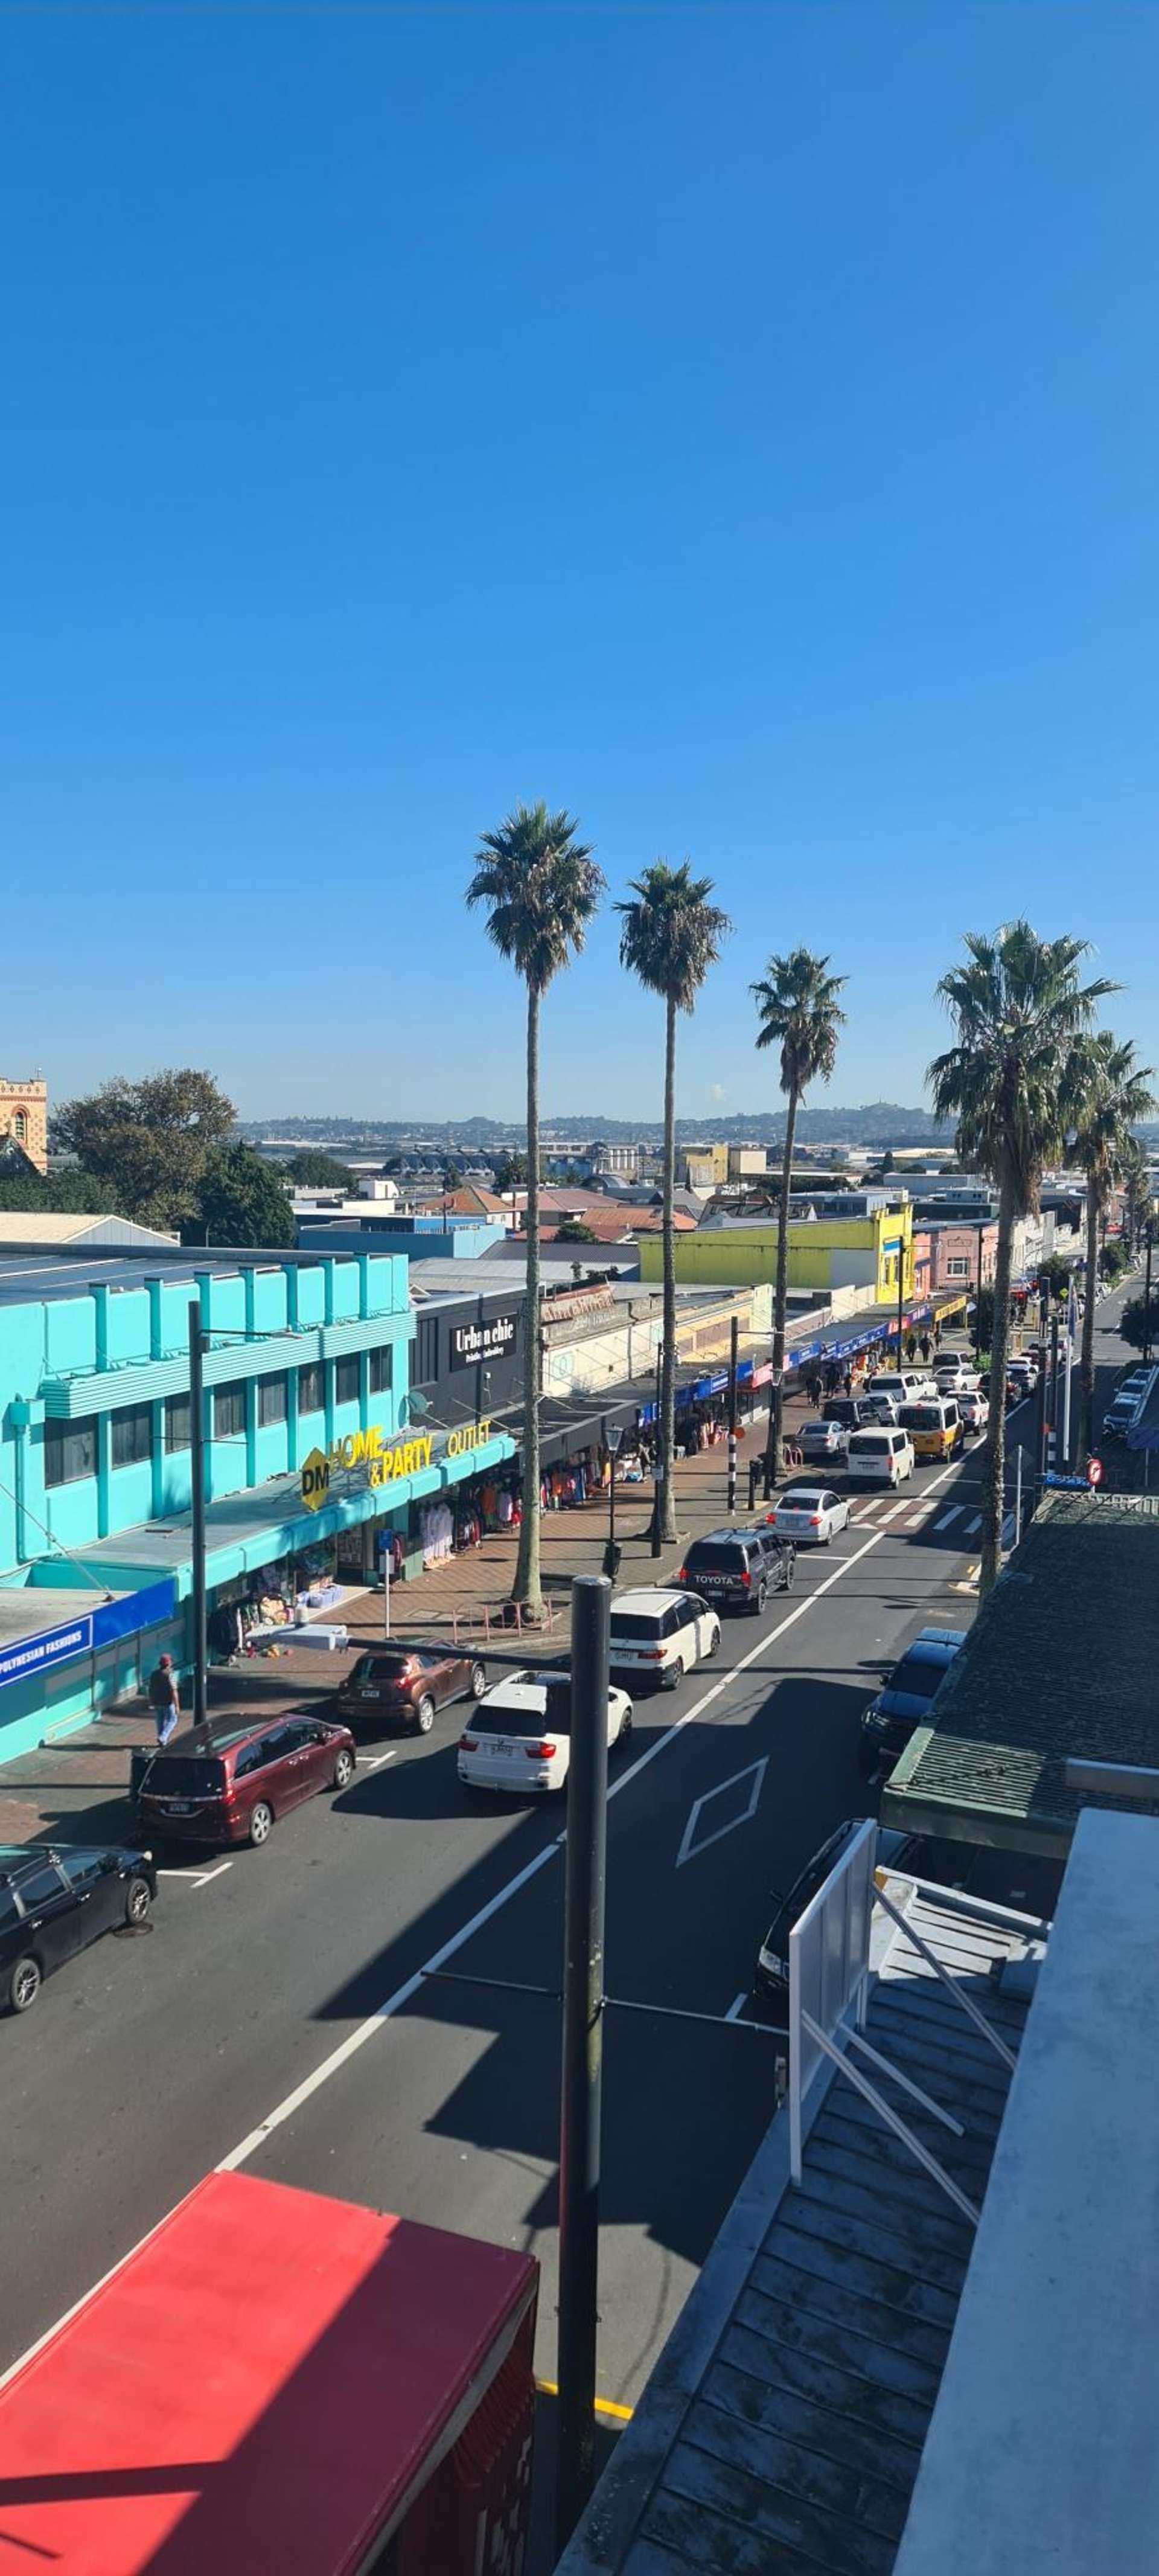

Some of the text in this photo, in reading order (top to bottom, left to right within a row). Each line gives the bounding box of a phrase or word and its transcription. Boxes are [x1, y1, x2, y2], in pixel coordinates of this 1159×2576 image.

[456, 1318, 513, 1351] Urban chic
[330, 1424, 382, 1472] HOME
[369, 1421, 491, 1488] & PARTY OUTLET
[302, 1463, 330, 1496] DM
[694, 1574, 733, 1585] TOYOTA
[46, 1630, 81, 1653] FASHIONS
